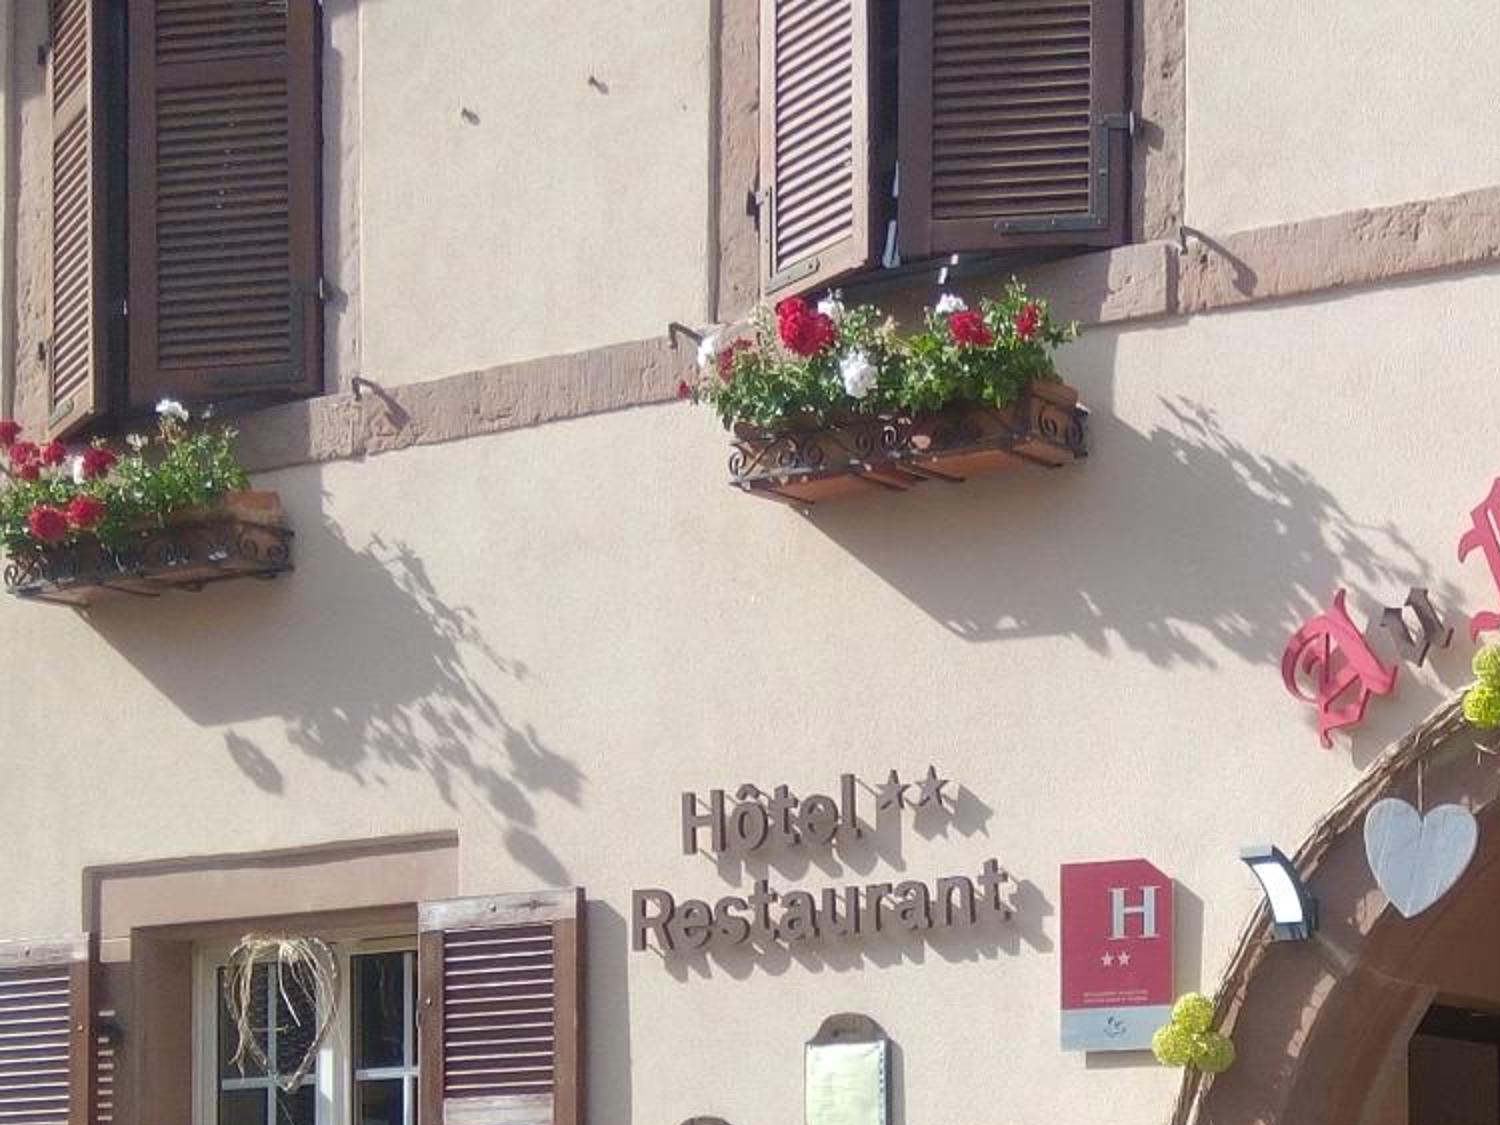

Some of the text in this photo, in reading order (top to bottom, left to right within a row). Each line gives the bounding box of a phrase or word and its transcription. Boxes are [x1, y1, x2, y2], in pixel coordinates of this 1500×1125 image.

[1281, 588, 1453, 749] Au
[681, 773, 863, 855] Hôtel
[631, 858, 1014, 952] Restaurant
[1106, 885, 1161, 941] H
